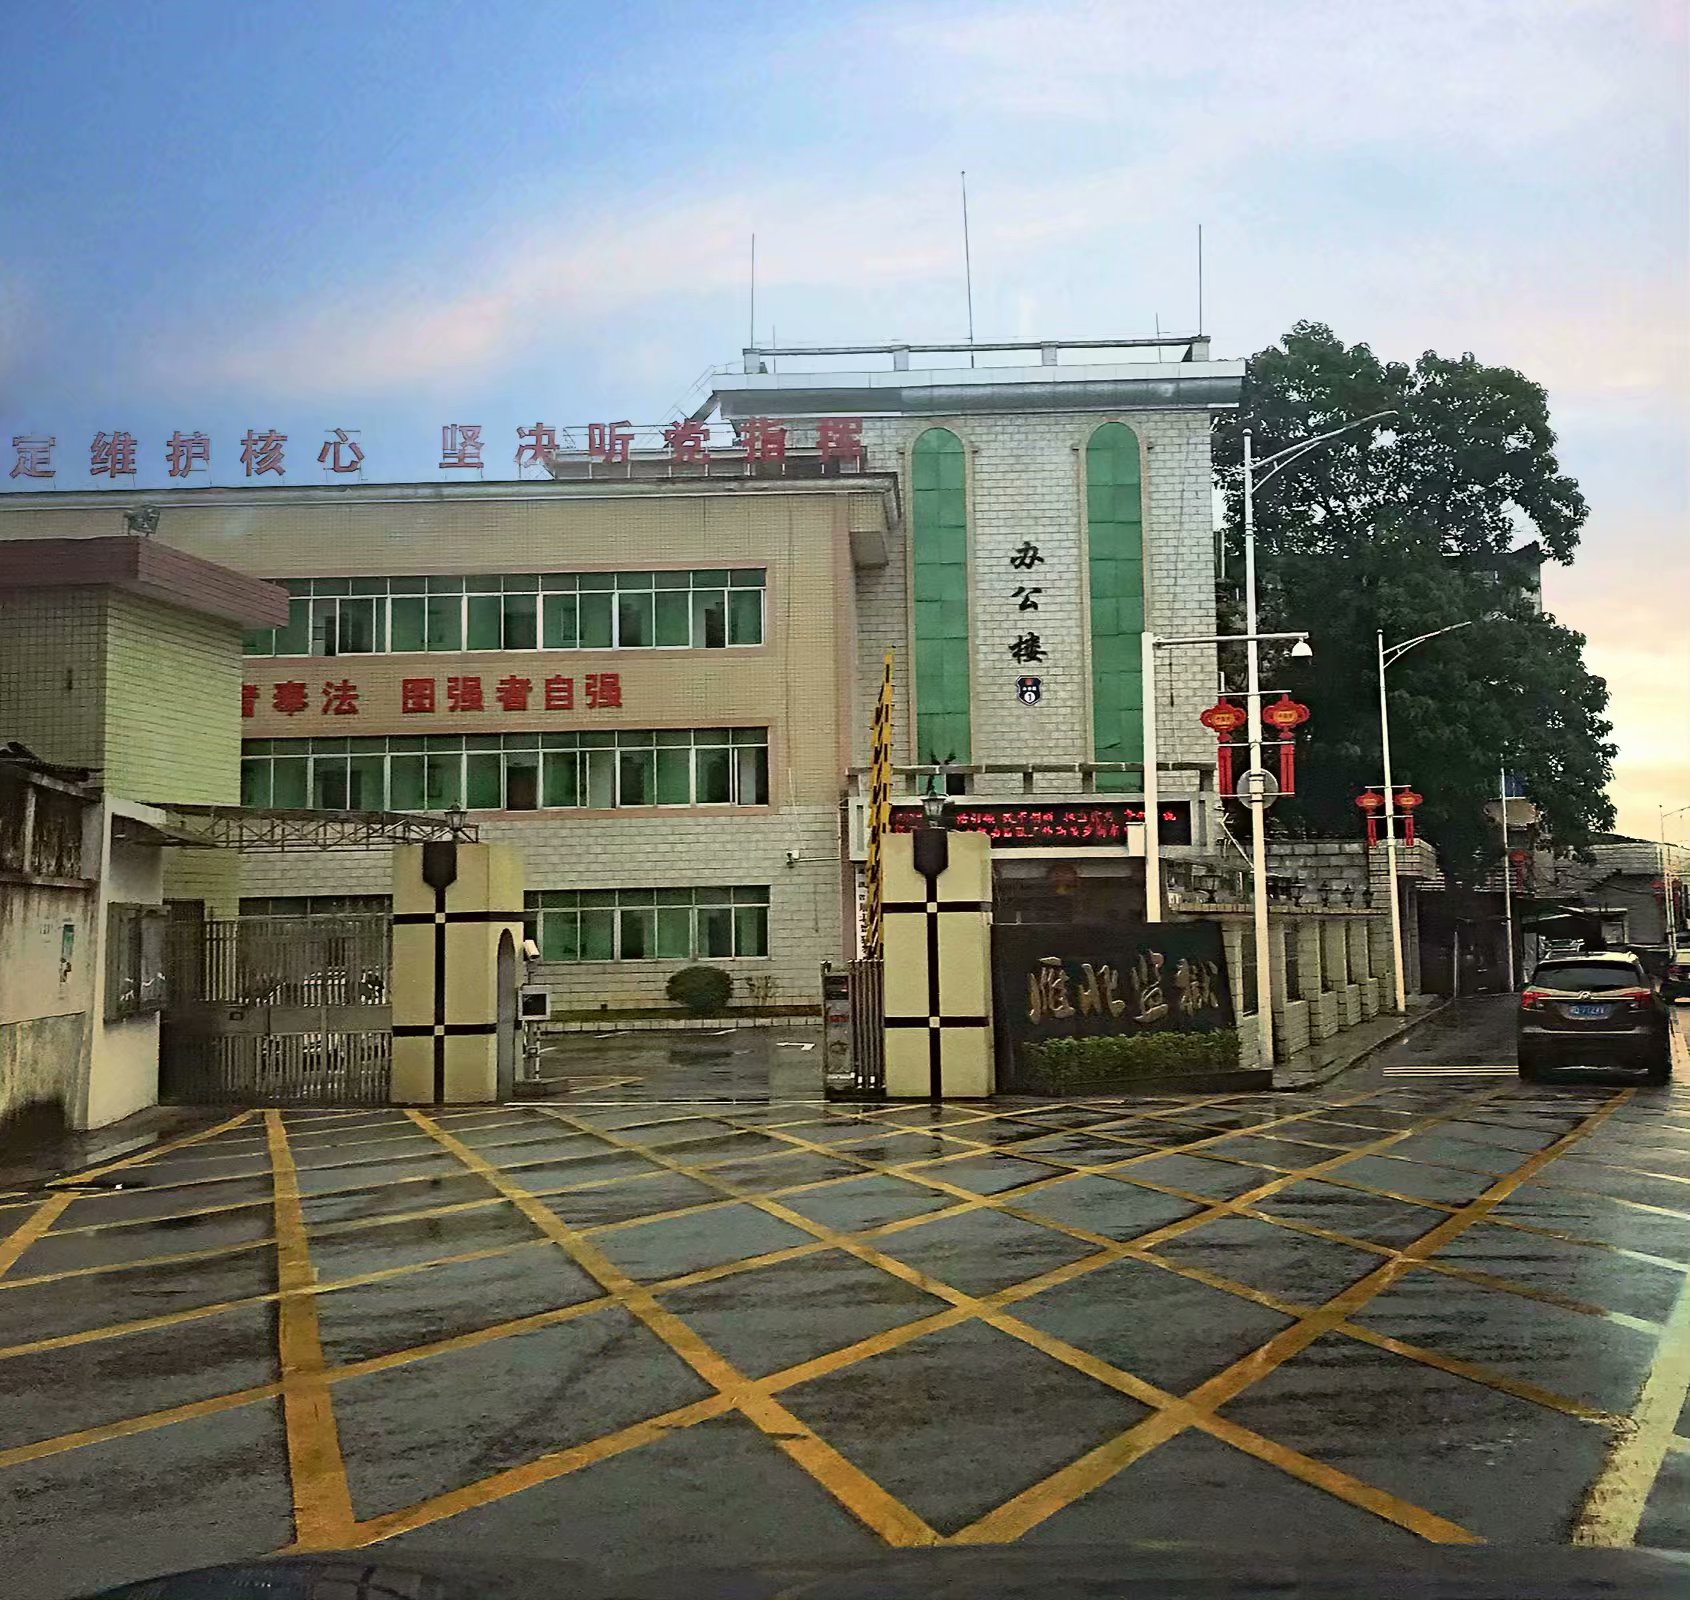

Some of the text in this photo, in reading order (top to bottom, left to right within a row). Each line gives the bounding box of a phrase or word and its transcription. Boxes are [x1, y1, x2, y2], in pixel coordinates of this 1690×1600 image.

[9, 417, 863, 479] 定维护核心 坚决听党指挥
[1009, 541, 1047, 664] 办公楼
